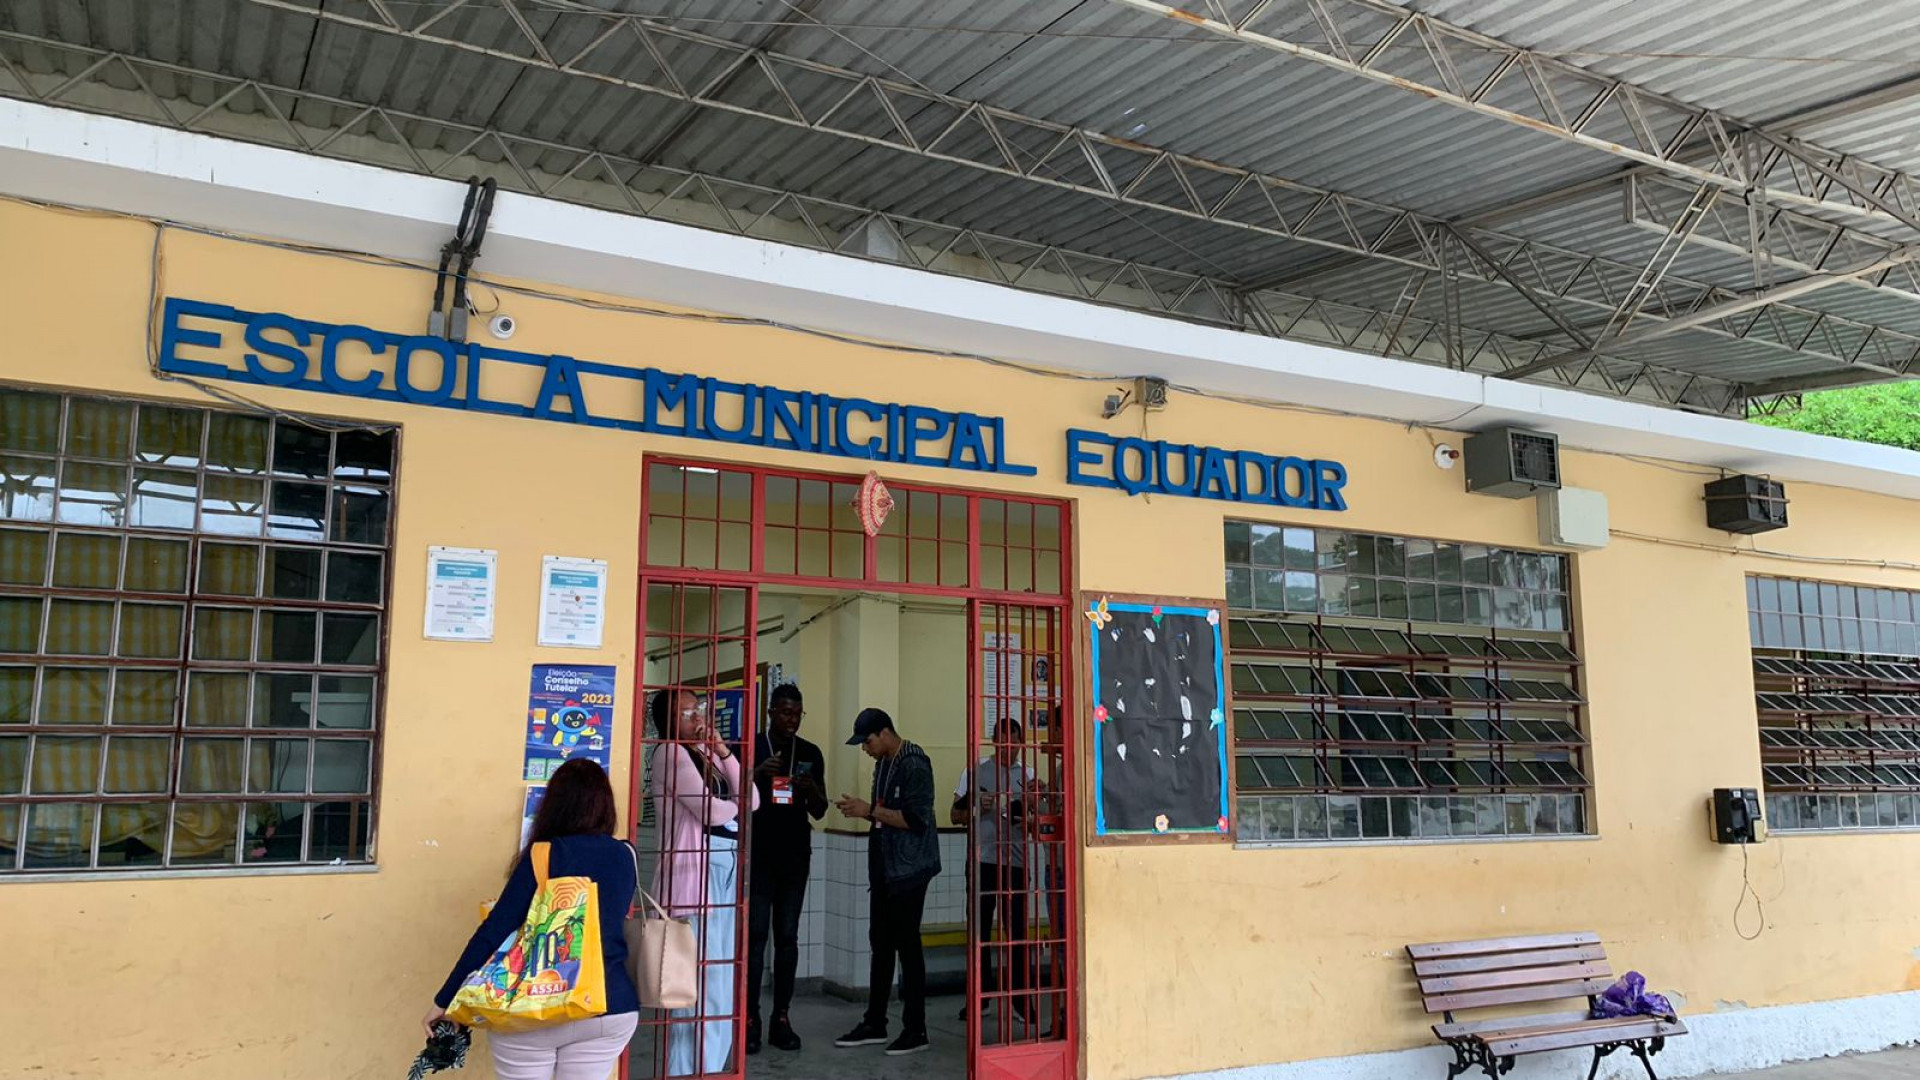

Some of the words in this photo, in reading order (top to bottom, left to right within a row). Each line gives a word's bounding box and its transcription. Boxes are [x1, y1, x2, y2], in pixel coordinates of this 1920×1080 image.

[159, 297, 589, 424] ESCOLA
[643, 367, 1037, 476] MUNICIPAL
[1066, 428, 1348, 511] EQUADOR
[548, 668, 577, 678] Eleição
[545, 676, 589, 685] Conselho
[544, 683, 578, 692] Tutelar
[581, 693, 612, 704] 2023
